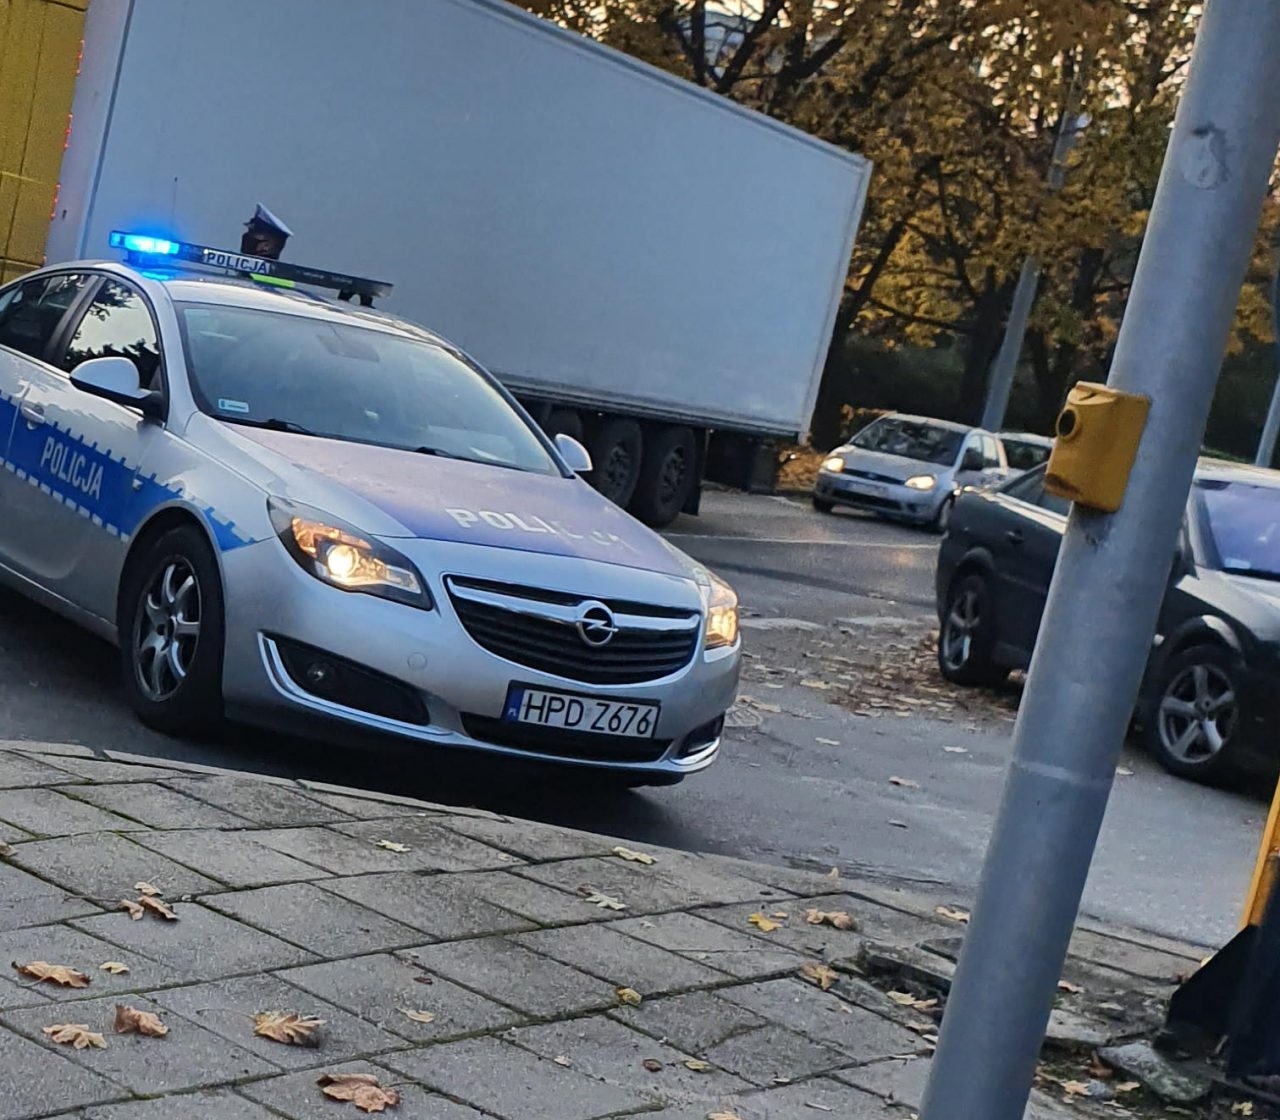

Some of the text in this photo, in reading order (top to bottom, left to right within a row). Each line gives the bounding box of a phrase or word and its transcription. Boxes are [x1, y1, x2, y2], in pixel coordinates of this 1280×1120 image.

[206, 252, 268, 274] POLICJA
[40, 436, 104, 501] POLICJA
[523, 693, 653, 735] HPD Z676
